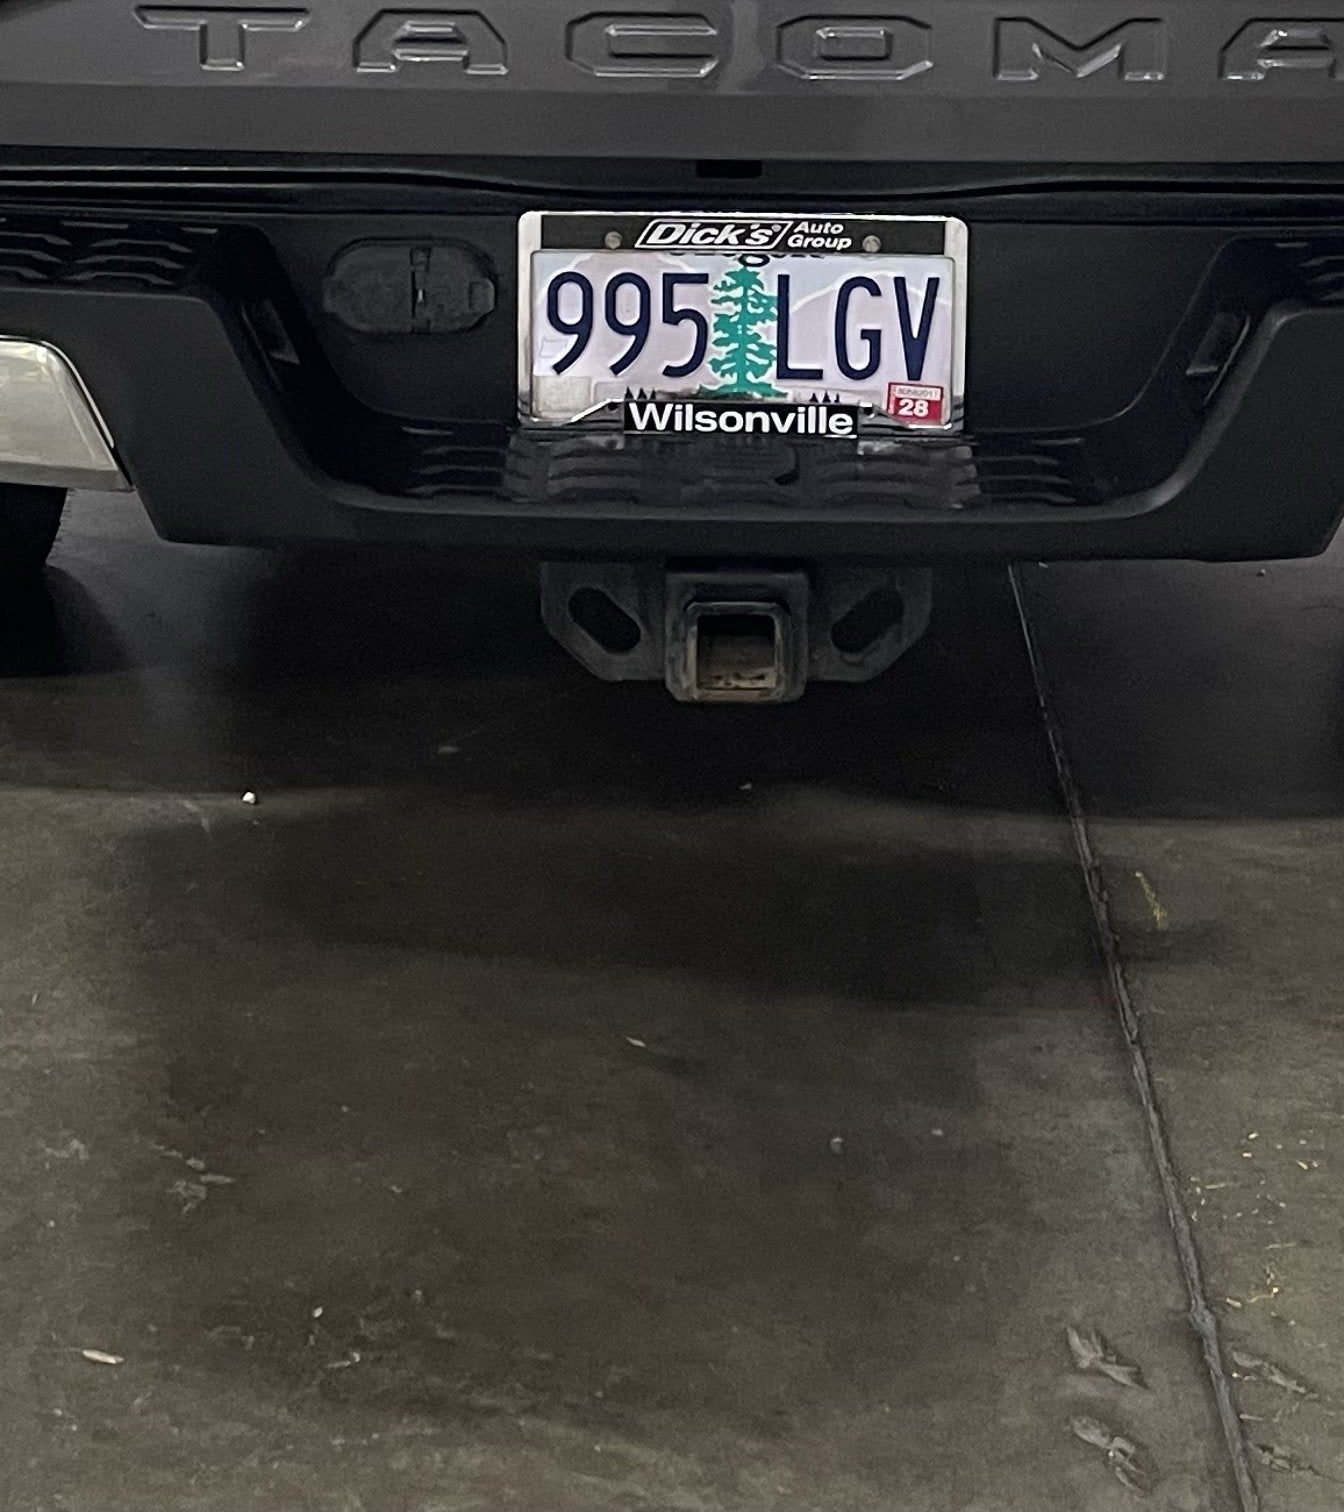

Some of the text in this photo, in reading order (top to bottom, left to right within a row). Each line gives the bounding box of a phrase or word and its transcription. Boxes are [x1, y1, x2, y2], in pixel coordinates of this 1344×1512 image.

[645, 222, 774, 246] Dick's
[793, 221, 844, 235] Auto
[787, 234, 852, 251] Group
[546, 271, 941, 382] 995 LGV
[898, 398, 929, 417] 28
[629, 402, 854, 435] Wilsonville
